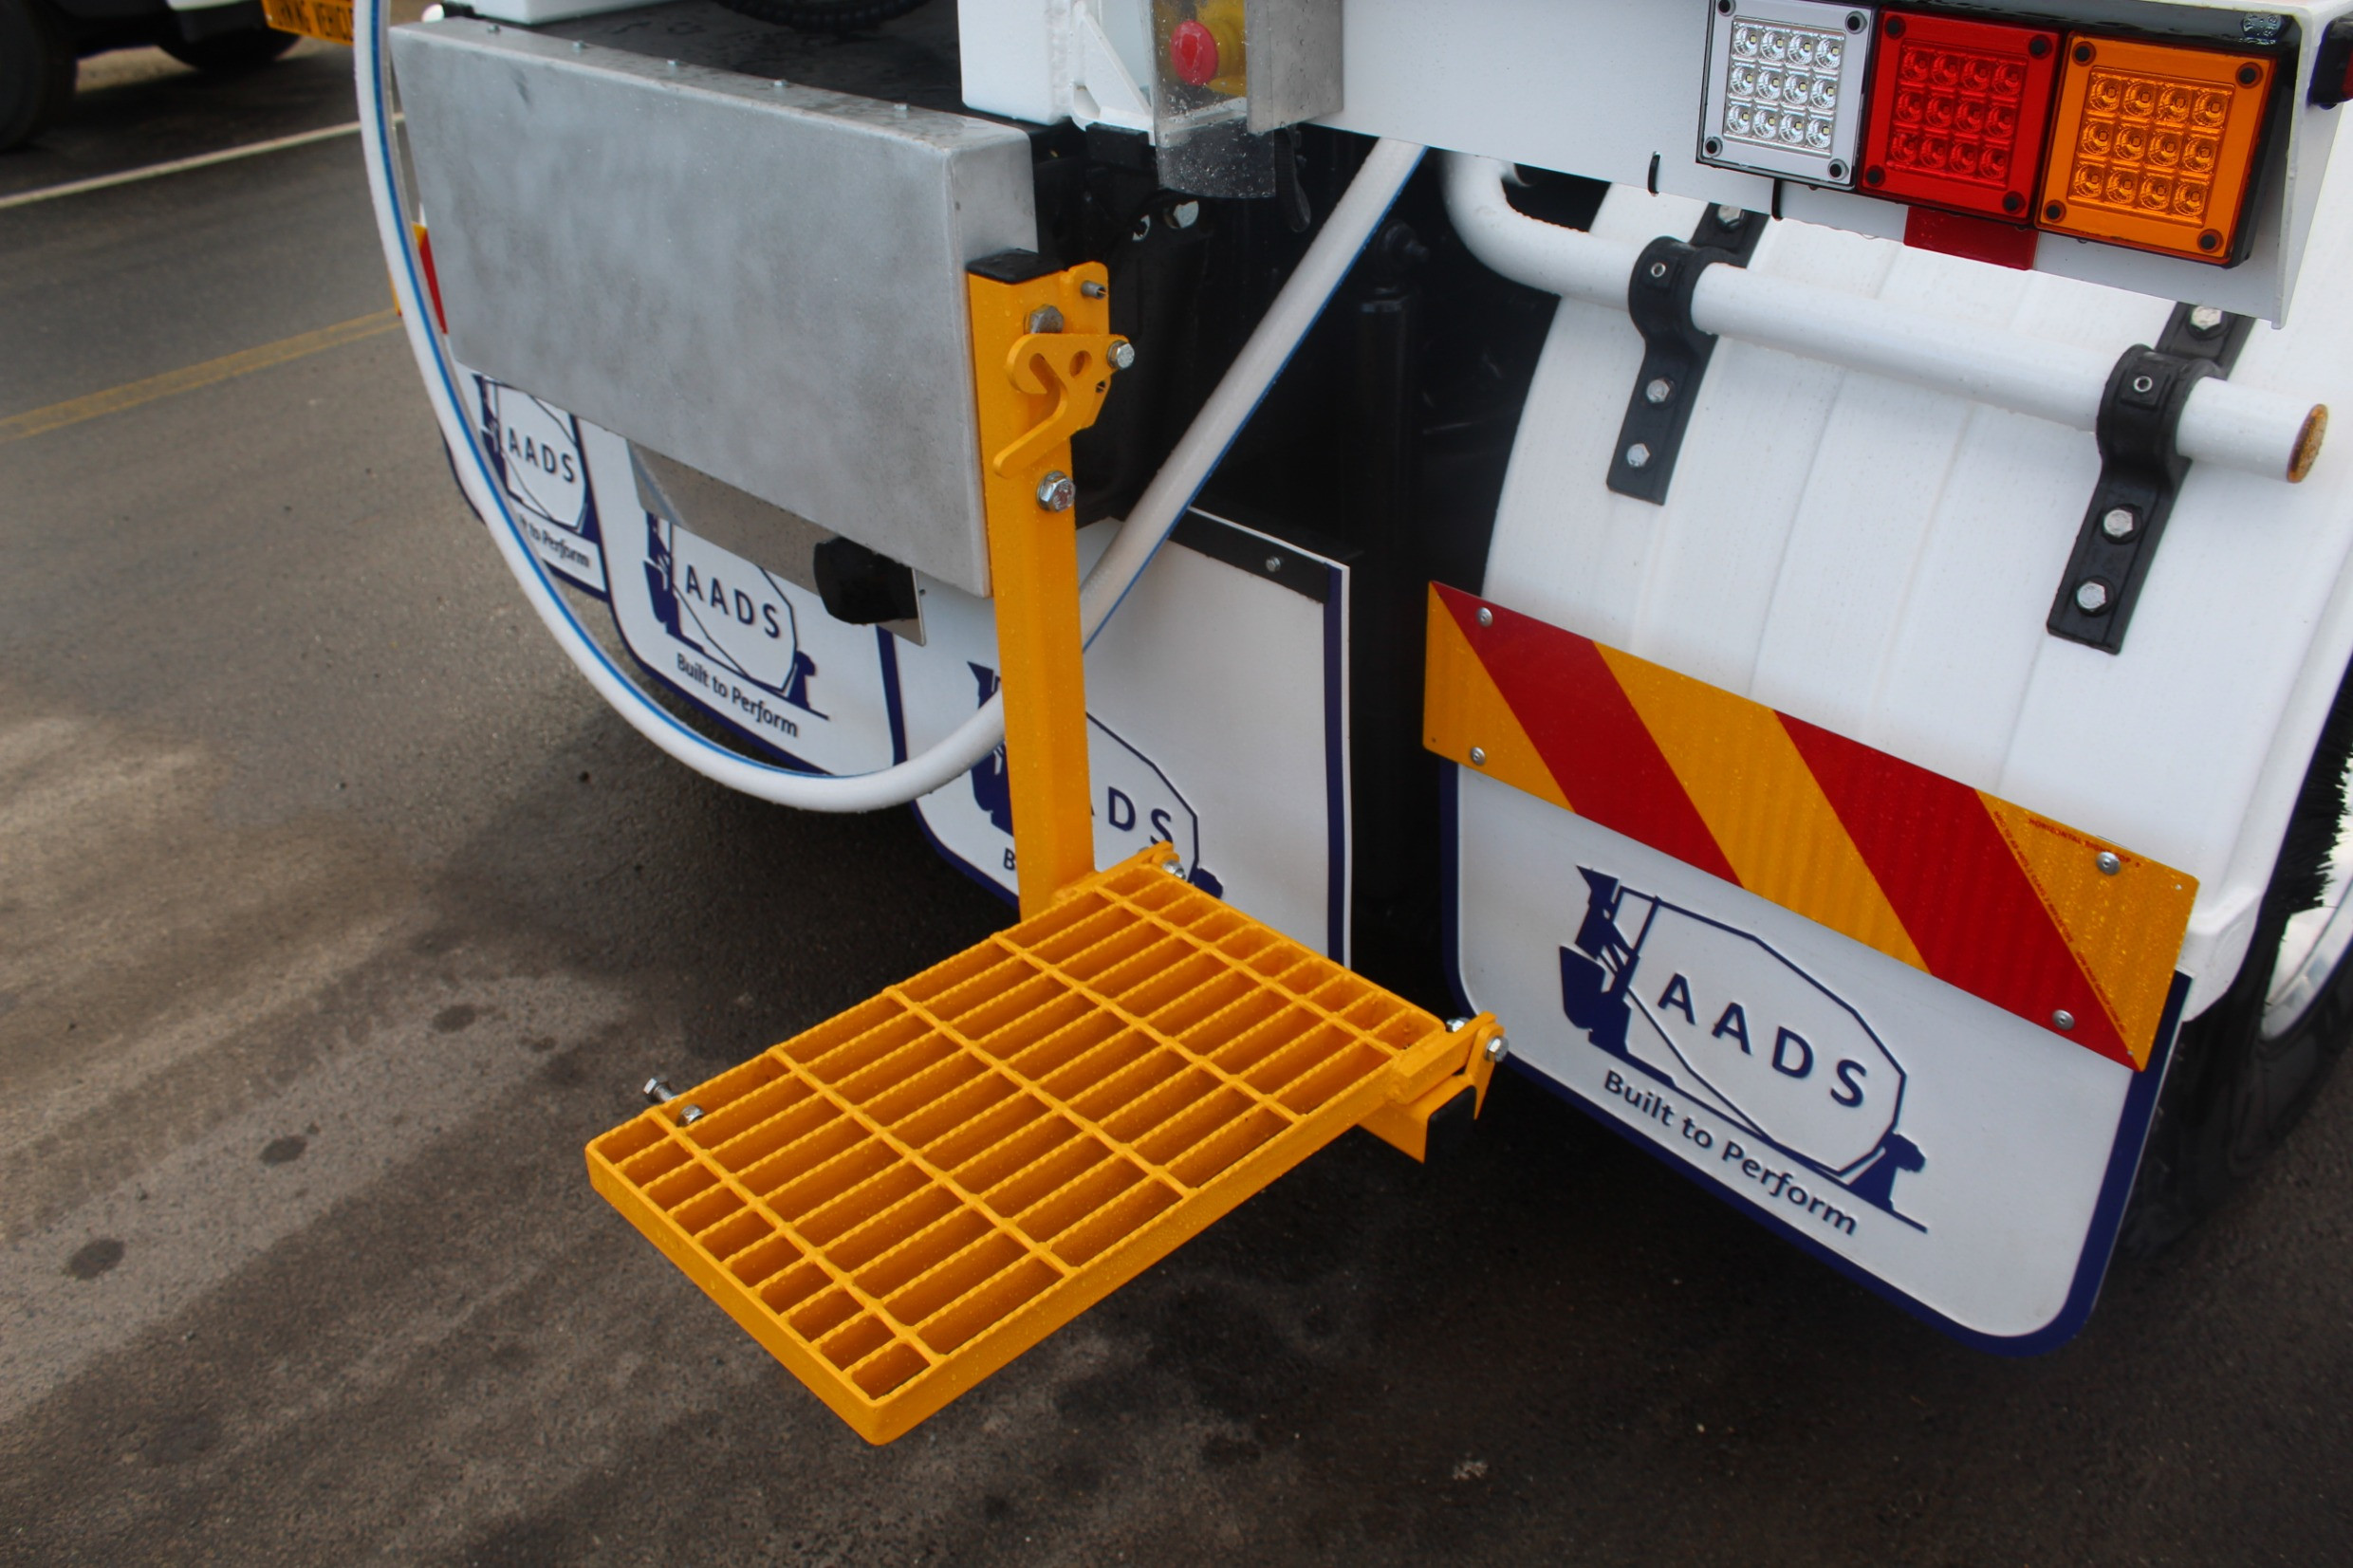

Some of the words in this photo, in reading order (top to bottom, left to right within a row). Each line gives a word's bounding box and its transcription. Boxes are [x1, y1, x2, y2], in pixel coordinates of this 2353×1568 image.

[508, 427, 576, 484] AADS
[543, 529, 590, 567] Perform
[685, 564, 780, 639] AADS
[676, 652, 711, 689] Built
[713, 676, 729, 698] to
[732, 686, 799, 738] Perform
[1091, 785, 1174, 846] DS
[1657, 972, 1867, 1109] AADS
[1604, 1070, 1675, 1127] Built
[1683, 1116, 1714, 1150] to
[1722, 1140, 1858, 1236] Perform
